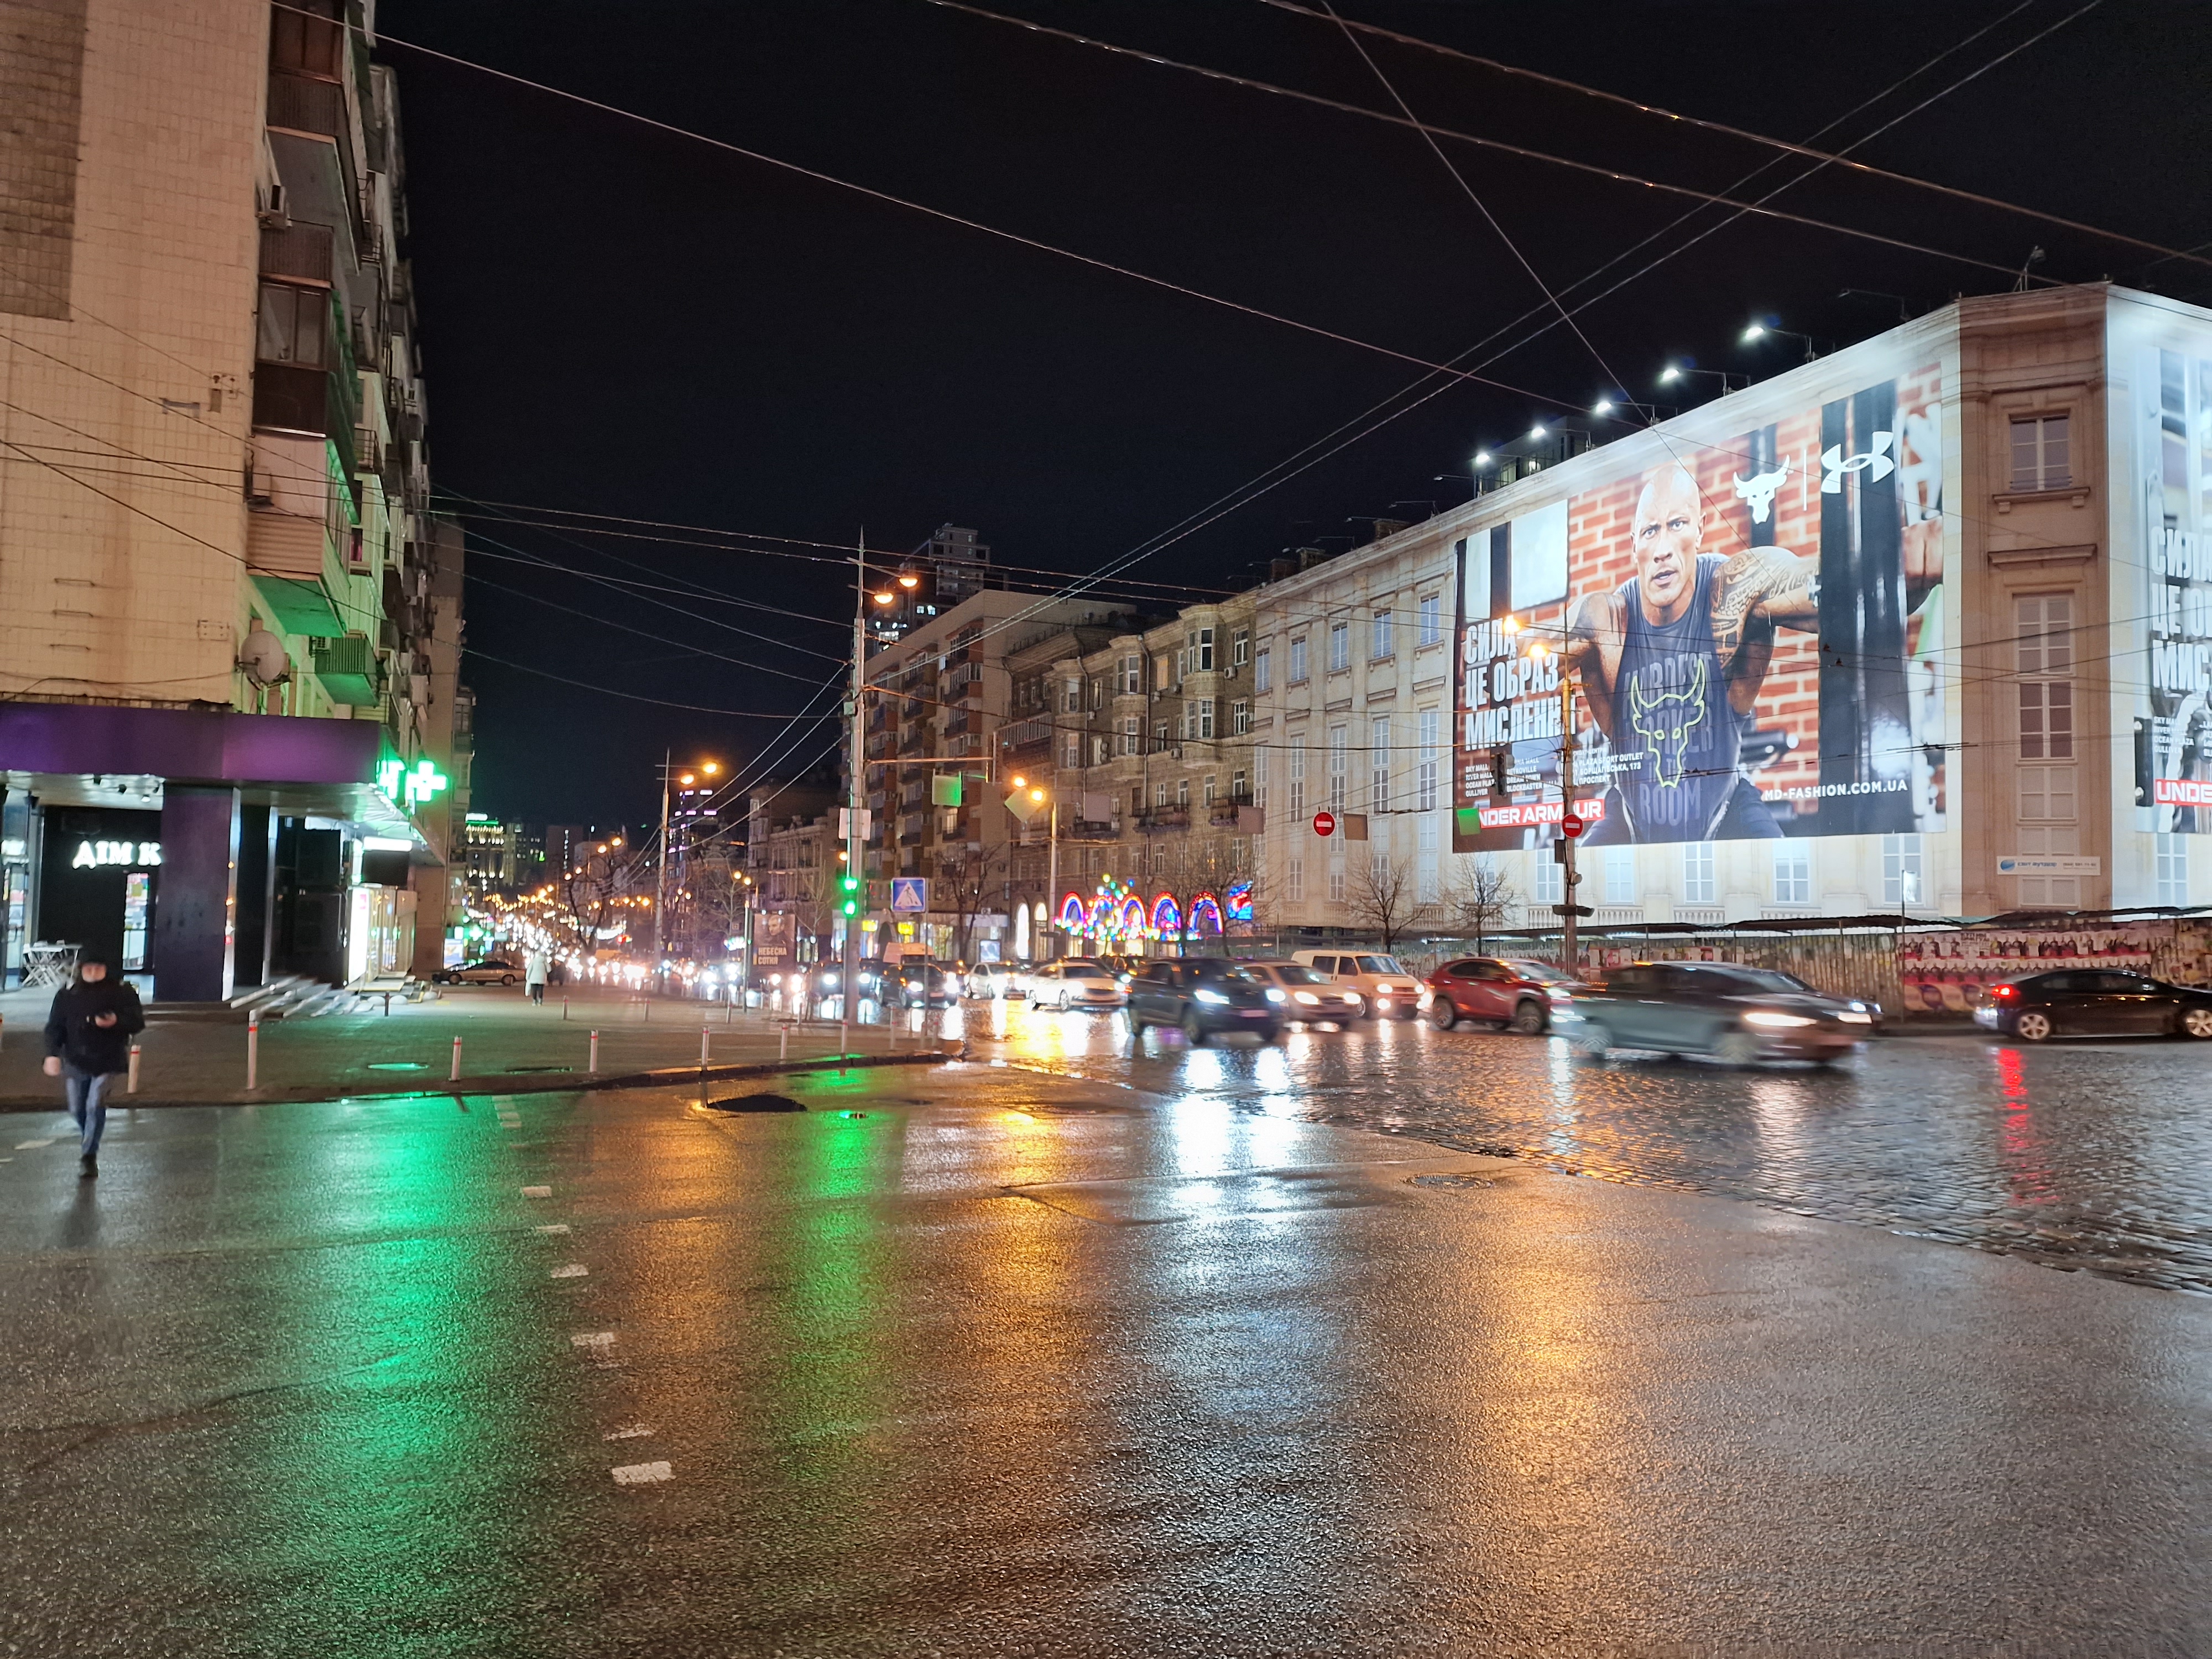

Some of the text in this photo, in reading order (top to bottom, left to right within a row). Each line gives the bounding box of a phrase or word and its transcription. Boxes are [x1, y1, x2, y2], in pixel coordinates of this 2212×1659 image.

[2152, 583, 2181, 640] ЦЕ
[1465, 615, 1516, 664] СИЛА
[1465, 653, 1559, 712] ЦЕ ОБРАЗ
[1475, 763, 1489, 771] MALL
[1579, 758, 1598, 766] PLAZA
[1598, 755, 1619, 764] SPORT
[1619, 752, 1644, 761] OUTLET
[1630, 761, 1641, 770] 173
[1465, 781, 1482, 789] OCEAN
[1579, 774, 1611, 785] ПРОСПЕКТ
[1465, 788, 1488, 797] GULLIVER
[1765, 779, 1908, 801] MD-FASHION.COM.UA
[1639, 778, 1700, 826] ROOM
[1479, 801, 1602, 826] NDER ARMUR
